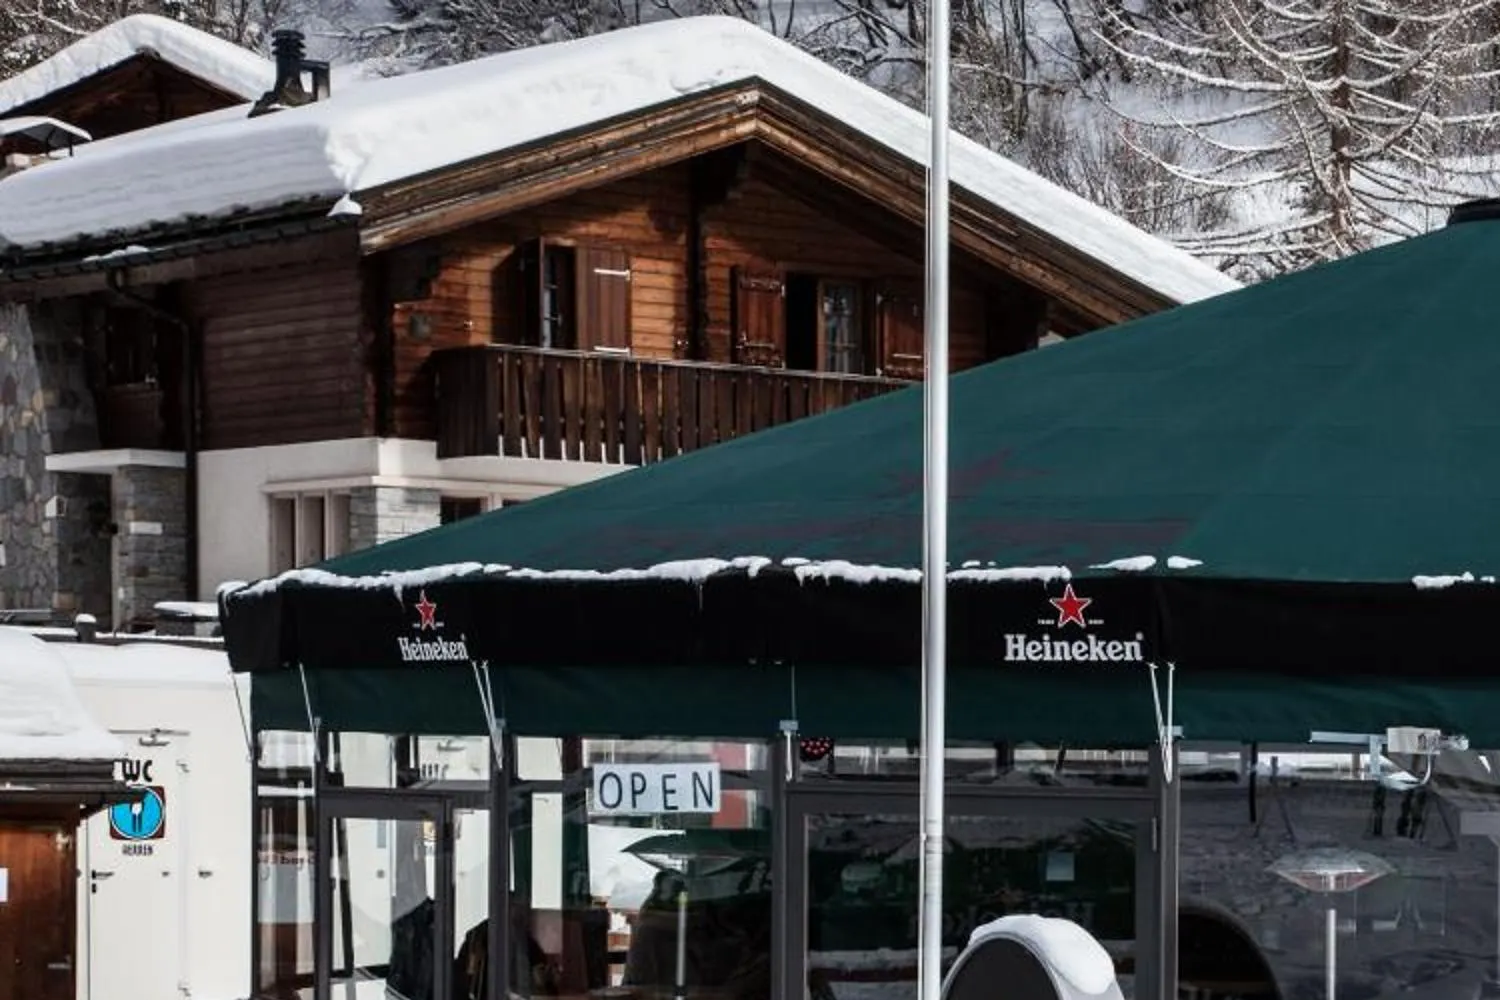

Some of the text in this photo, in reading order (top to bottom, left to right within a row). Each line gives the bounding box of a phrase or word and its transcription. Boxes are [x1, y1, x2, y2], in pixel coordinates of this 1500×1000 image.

[397, 635, 468, 661] Heineken
[1004, 633, 1143, 661] Heineken
[122, 759, 152, 782] WC
[599, 771, 713, 810] OPEN
